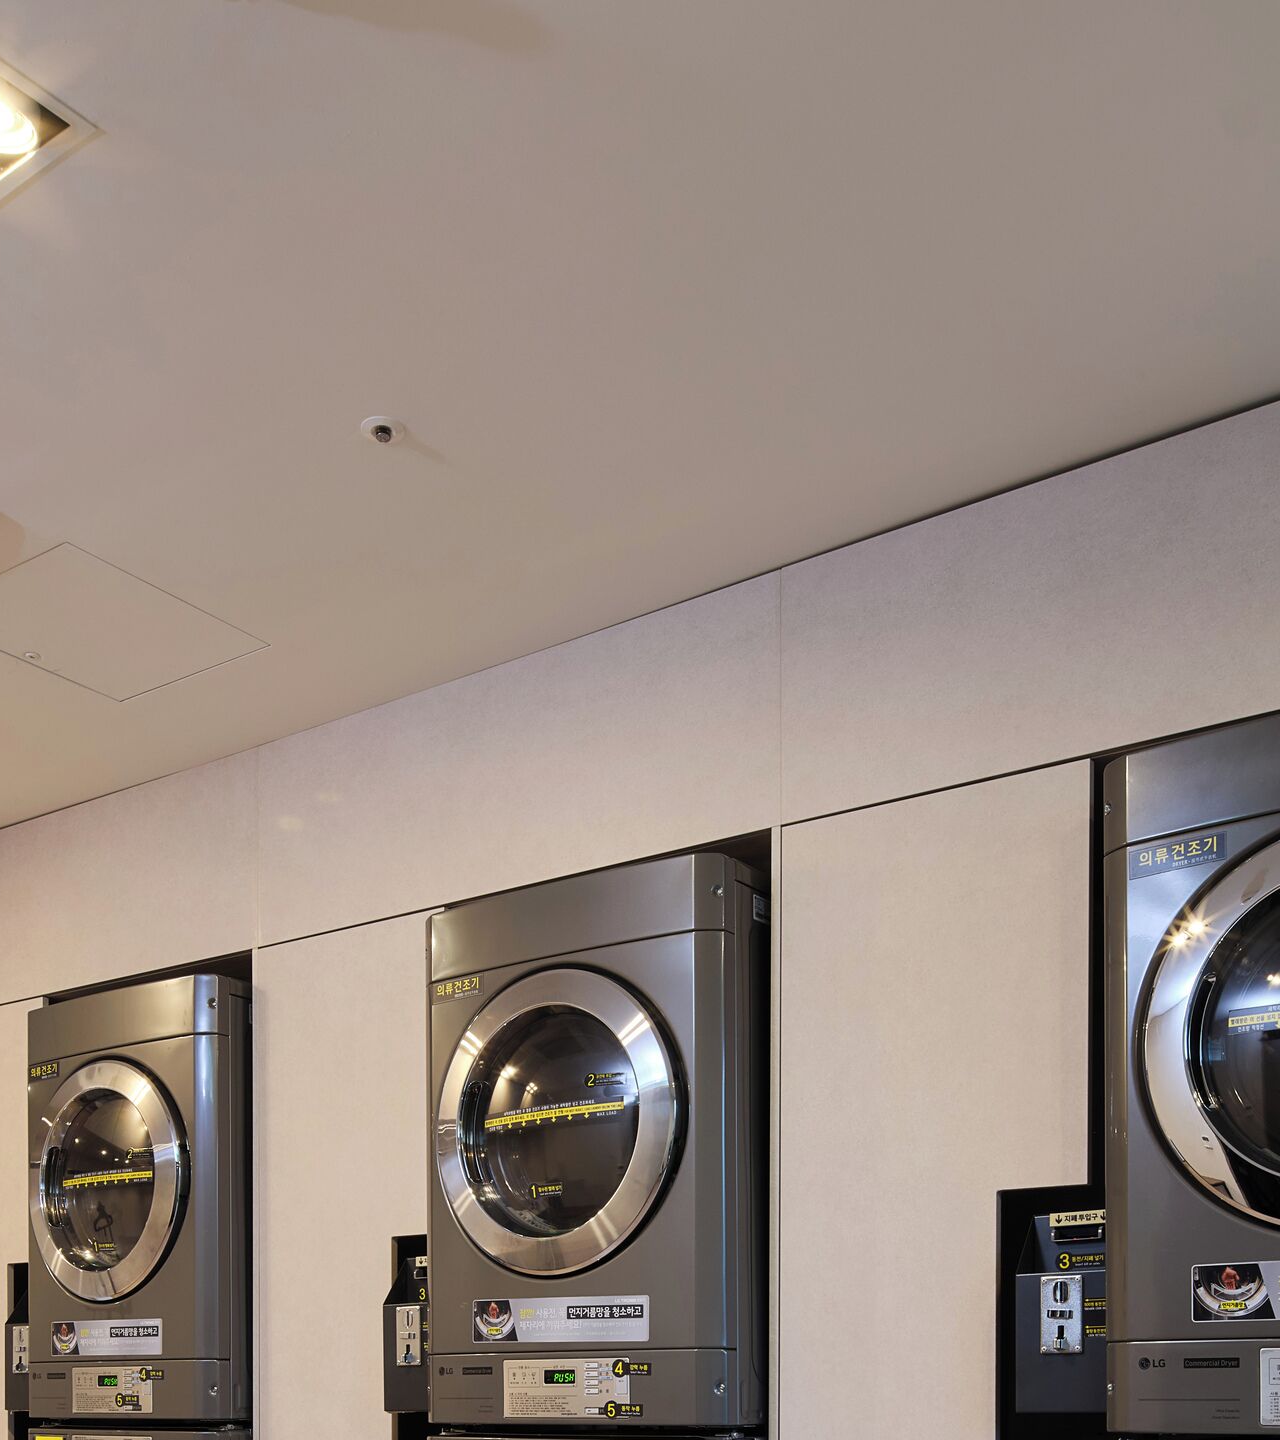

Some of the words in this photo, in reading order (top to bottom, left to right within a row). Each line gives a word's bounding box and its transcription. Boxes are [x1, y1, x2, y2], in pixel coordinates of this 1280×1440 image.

[1138, 835, 1217, 867] 의류건조기
[436, 976, 479, 996] 의류건조기
[30, 1062, 58, 1078] 의류건조기
[587, 1073, 595, 1087] 2
[127, 1148, 134, 1160] 2
[531, 1184, 537, 1199] 1
[1059, 1253, 1070, 1269] 3
[419, 1288, 426, 1300] 3
[568, 1305, 611, 1319] 먼지거름망을
[612, 1305, 642, 1318] 청소하고
[1152, 1359, 1166, 1368] LG
[140, 1368, 147, 1381] 4
[553, 1373, 575, 1383] PUSH
[116, 1394, 123, 1406] 5
